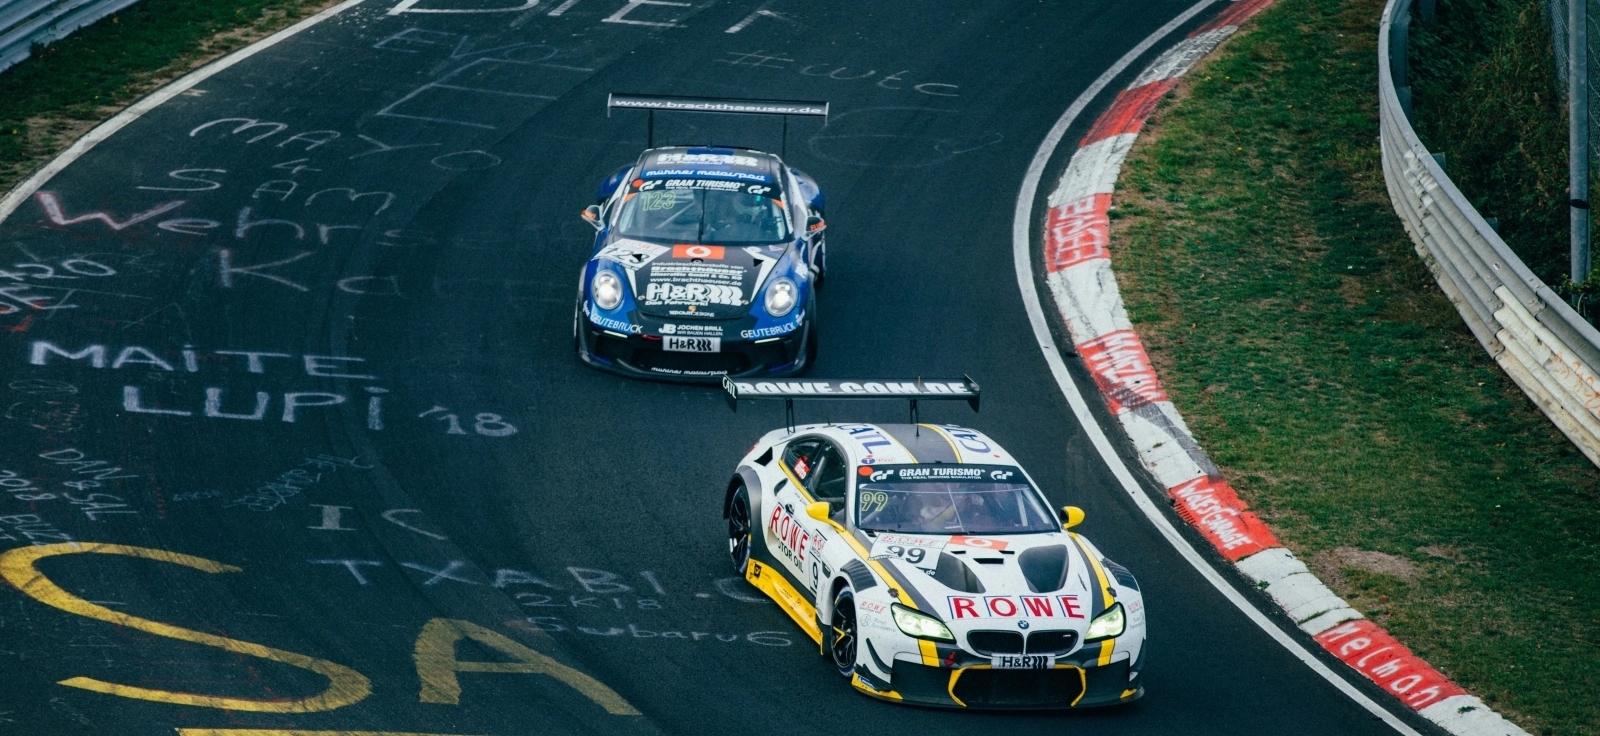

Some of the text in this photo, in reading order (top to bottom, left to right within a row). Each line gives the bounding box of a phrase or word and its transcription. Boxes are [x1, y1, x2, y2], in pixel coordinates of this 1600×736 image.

[614, 99, 823, 115] www.brachthaeuser.de
[665, 179, 695, 188] GRAN
[642, 191, 676, 212] 123
[677, 324, 704, 332] JOCHEN
[669, 338, 697, 351] H&R
[722, 376, 737, 400] CATL
[899, 468, 930, 478] GRAN
[858, 491, 889, 512] 99
[769, 506, 810, 562] ROWE
[886, 545, 926, 565] 99
[860, 601, 887, 613] ROWE
[949, 595, 1085, 619] ROWE
[1002, 655, 1032, 669] H&R
